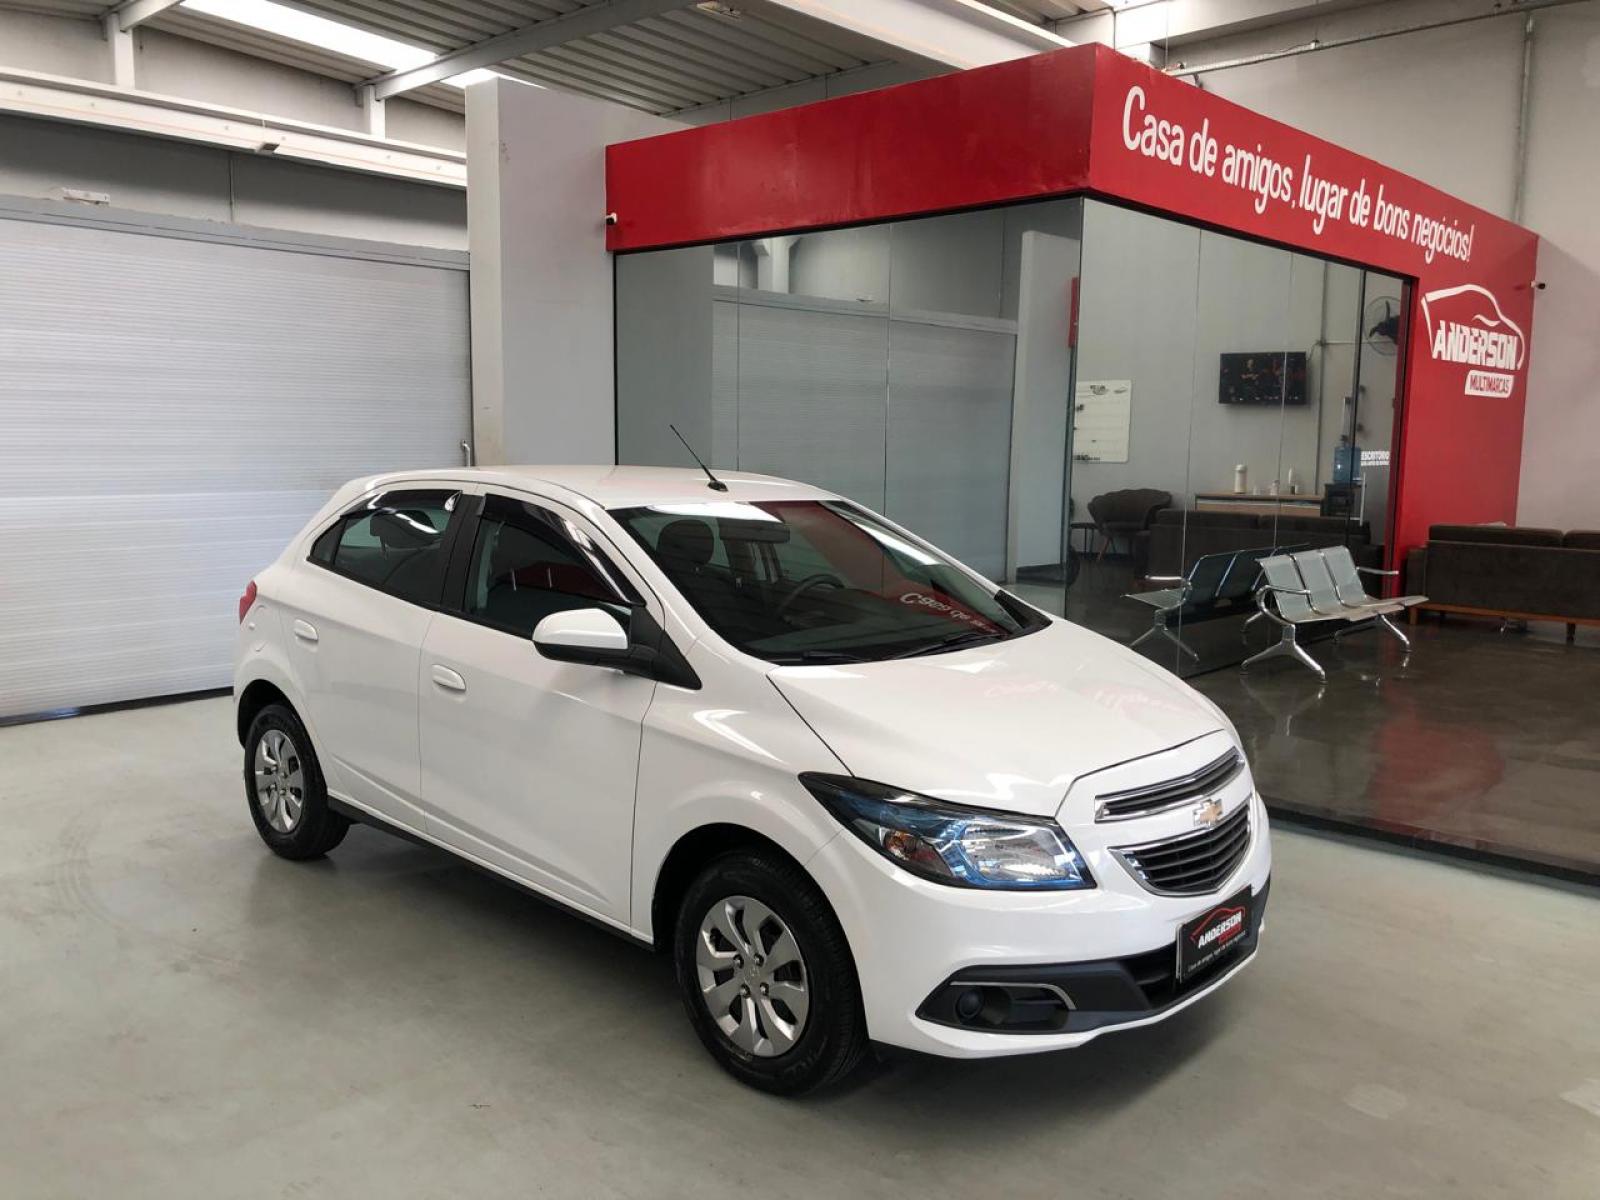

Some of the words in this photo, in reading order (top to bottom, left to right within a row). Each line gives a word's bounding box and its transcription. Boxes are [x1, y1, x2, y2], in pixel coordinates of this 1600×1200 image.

[1122, 85, 1185, 167] Casa
[1189, 117, 1218, 178] de
[1221, 143, 1296, 215] amigos,
[1299, 153, 1349, 236] lugar
[1349, 177, 1371, 228] de
[1373, 183, 1411, 241] bons
[1411, 215, 1475, 265] negócios!
[1432, 319, 1518, 371] ANDERSON
[1468, 373, 1511, 393] MULTIMARCAS
[1198, 910, 1243, 949] ANDERSON
